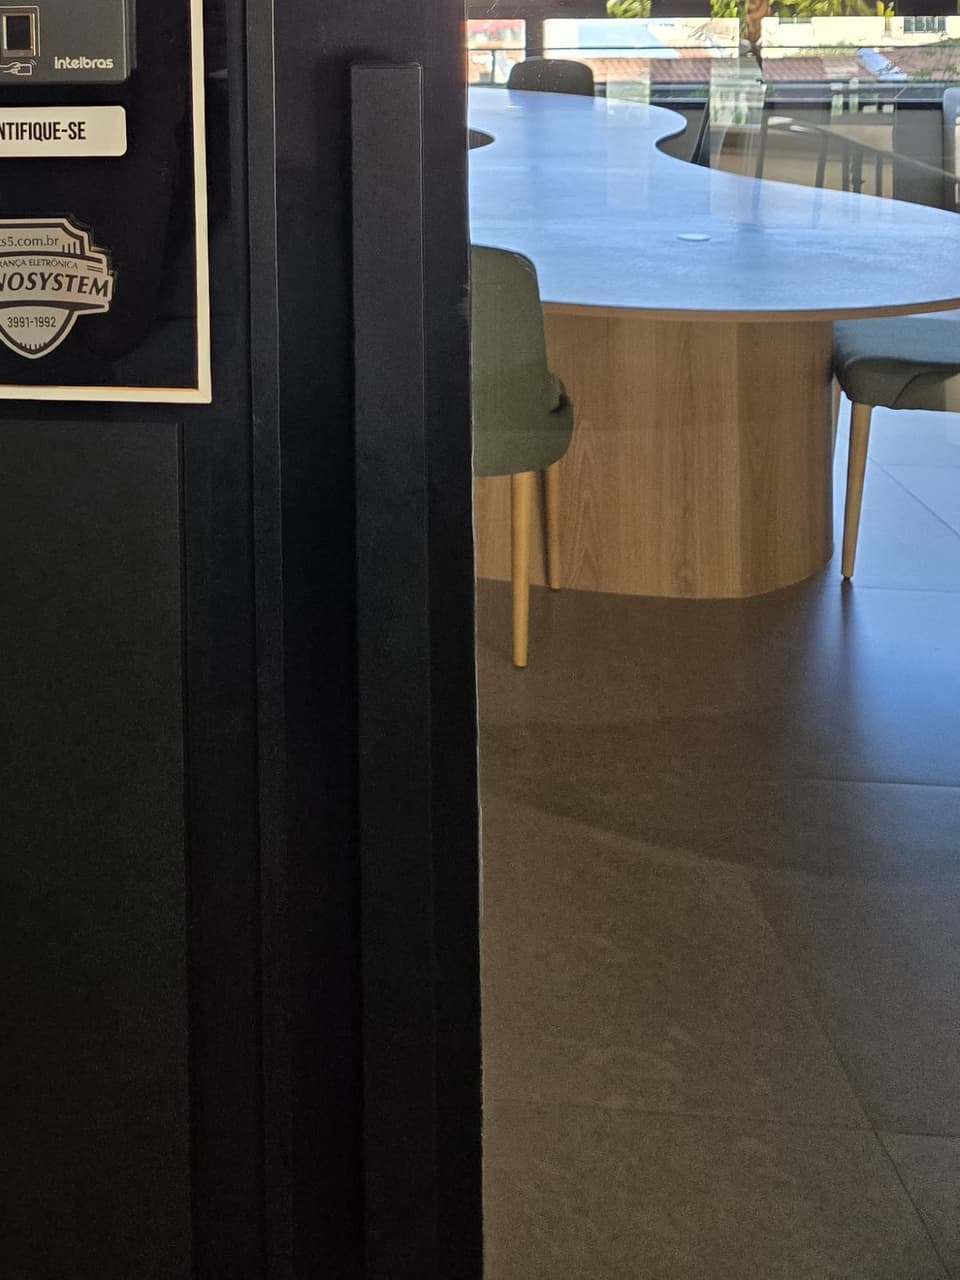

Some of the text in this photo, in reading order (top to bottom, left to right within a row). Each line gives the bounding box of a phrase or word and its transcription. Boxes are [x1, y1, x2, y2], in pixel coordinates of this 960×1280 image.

[54, 56, 114, 69] intelbras
[28, 257, 78, 270] ELETRÔNICA
[7, 316, 57, 328] 3991-1992
